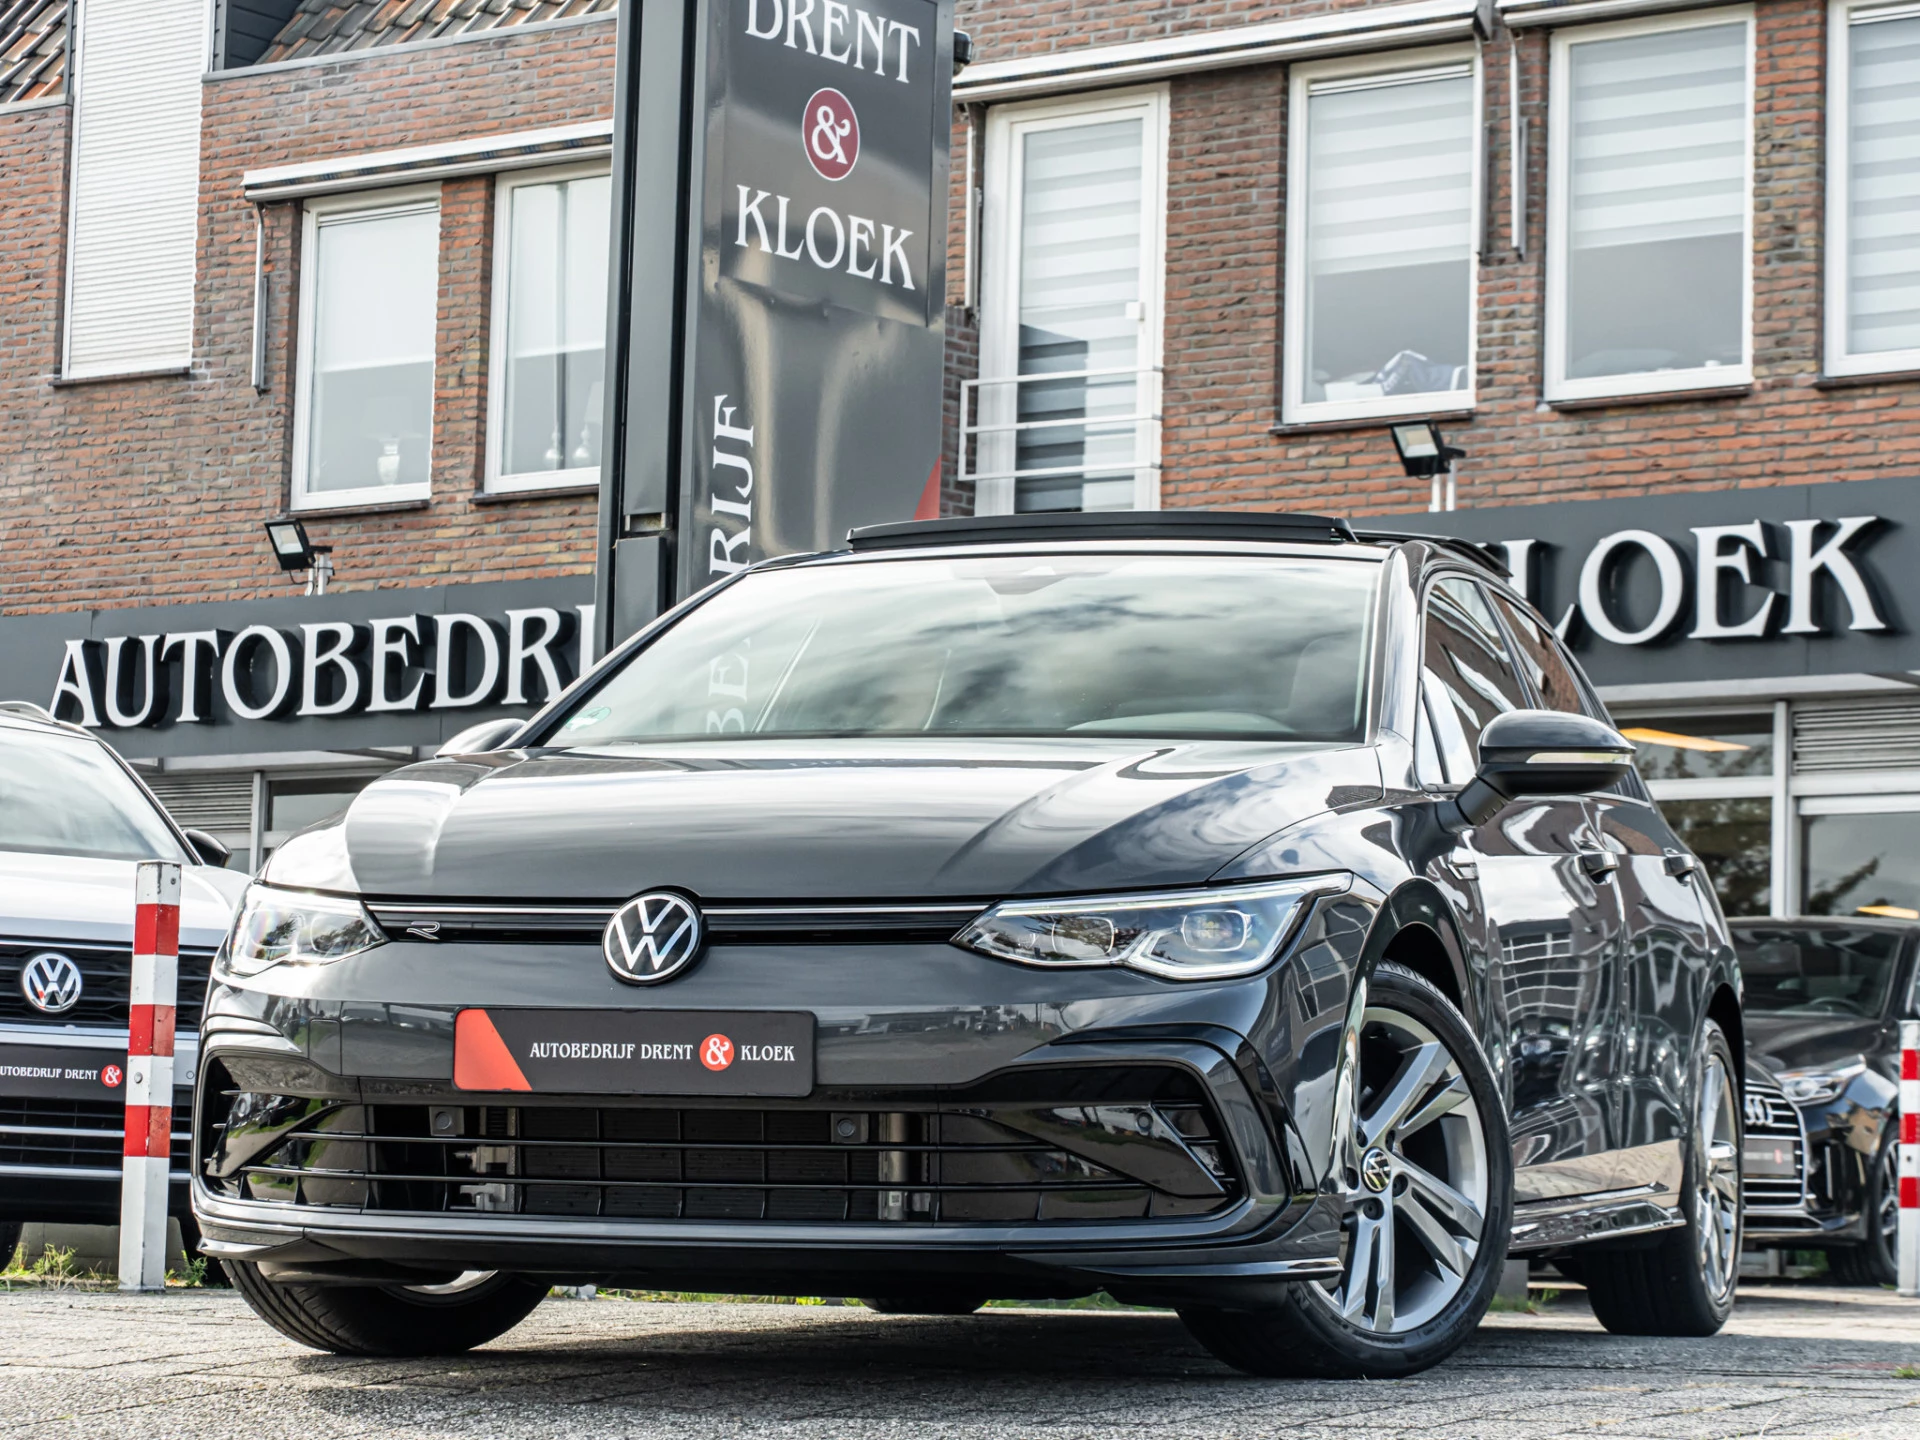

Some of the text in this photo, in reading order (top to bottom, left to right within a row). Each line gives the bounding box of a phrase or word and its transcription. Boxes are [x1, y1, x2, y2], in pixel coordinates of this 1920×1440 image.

[745, 0, 921, 84] DRENT
[811, 105, 851, 165] &
[735, 184, 916, 291] KLOEK
[1476, 515, 1887, 646] LOEK
[64, 1069, 98, 1081] DRENT
[105, 1066, 121, 1085] &
[529, 1036, 796, 1066] AUTOBEDRIJF DRENT & KLOEK
